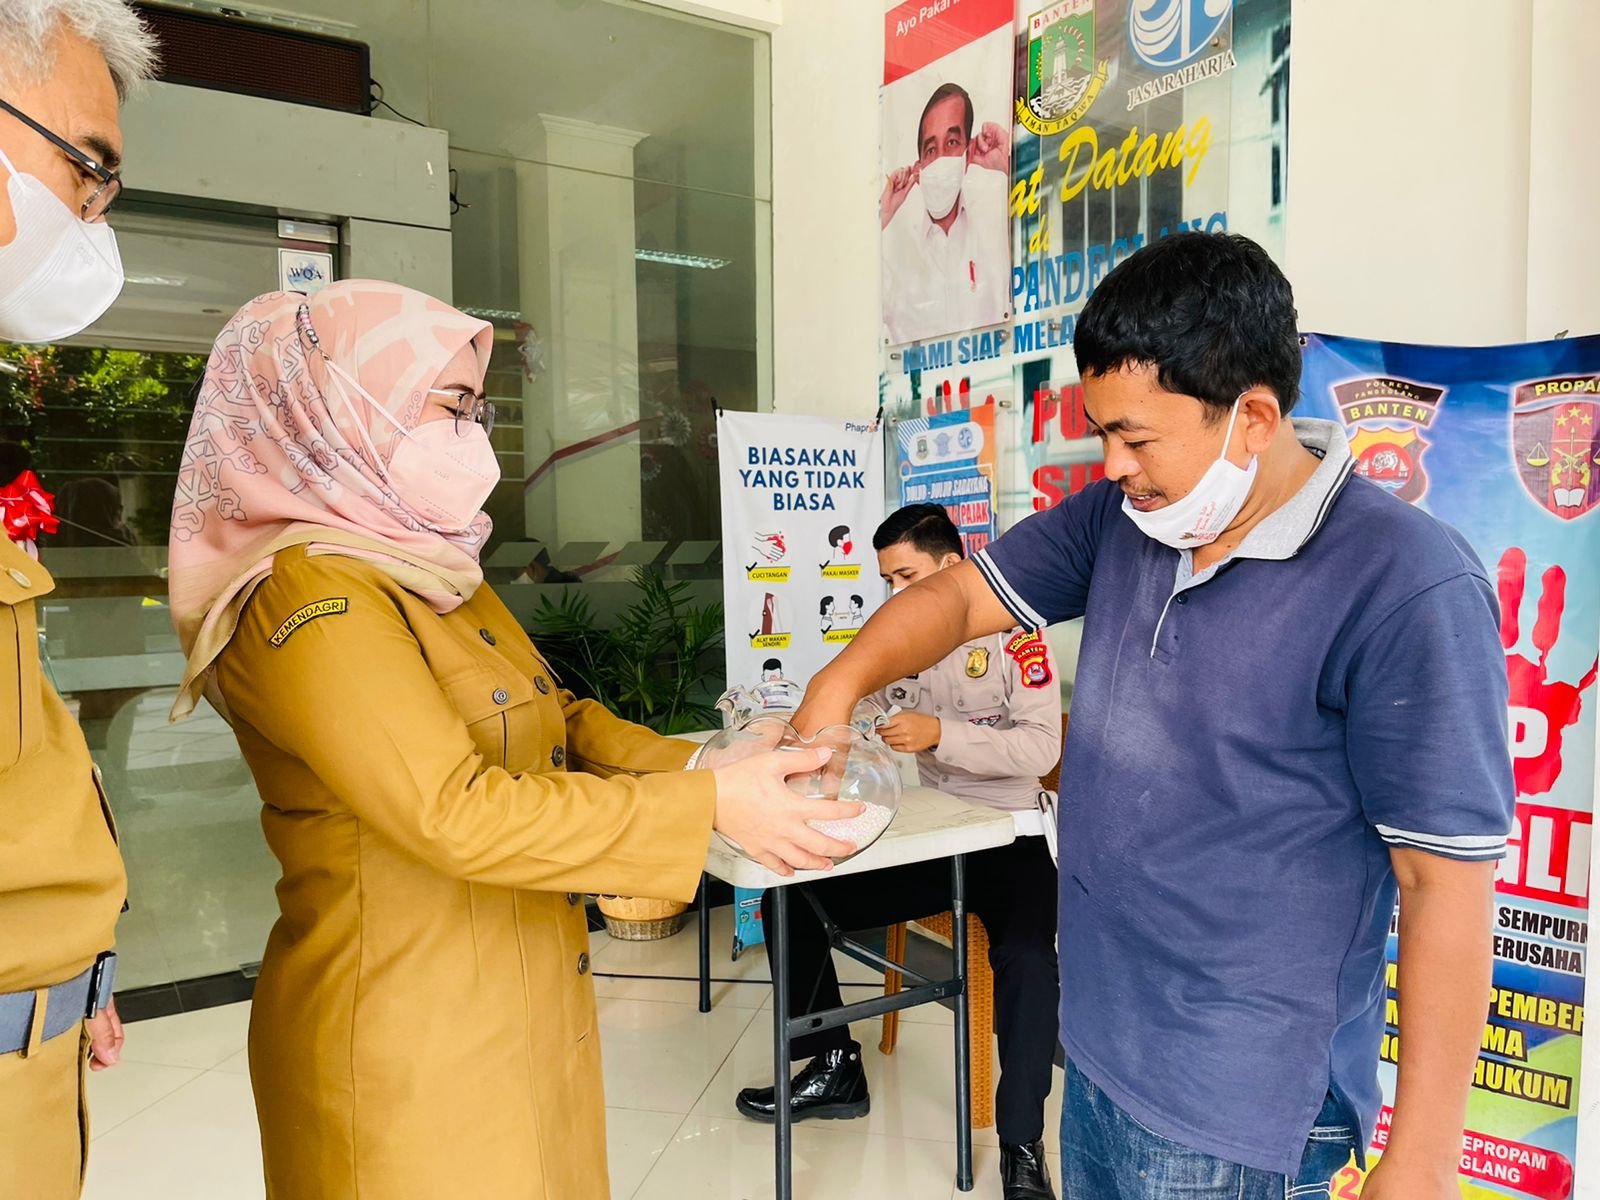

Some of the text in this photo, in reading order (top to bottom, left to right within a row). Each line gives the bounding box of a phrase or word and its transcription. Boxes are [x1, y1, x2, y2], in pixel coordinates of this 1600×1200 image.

[895, 15, 917, 37] Ayo
[1025, 95, 1093, 133] IMAN TAQWA
[1059, 115, 1213, 203] Datang
[902, 313, 1080, 375] KAMI SIAP MELA
[1355, 388, 1420, 399] PANDEGLANG
[1366, 380, 1410, 390] POLRES
[1535, 379, 1600, 397] PROPA
[1350, 402, 1427, 421] BANTEN
[748, 446, 856, 467] BIASAKAN
[738, 468, 865, 489] YANG TIDAK
[773, 492, 836, 511] BIASA
[961, 502, 989, 525] PAJAK
[765, 571, 788, 579] TANGAN
[273, 601, 344, 644] KEMENDAGRI
[1472, 1059, 1568, 1105] HUKUM
[1462, 1135, 1547, 1170] EPROPAM
[1459, 1154, 1521, 1183] GLANG
